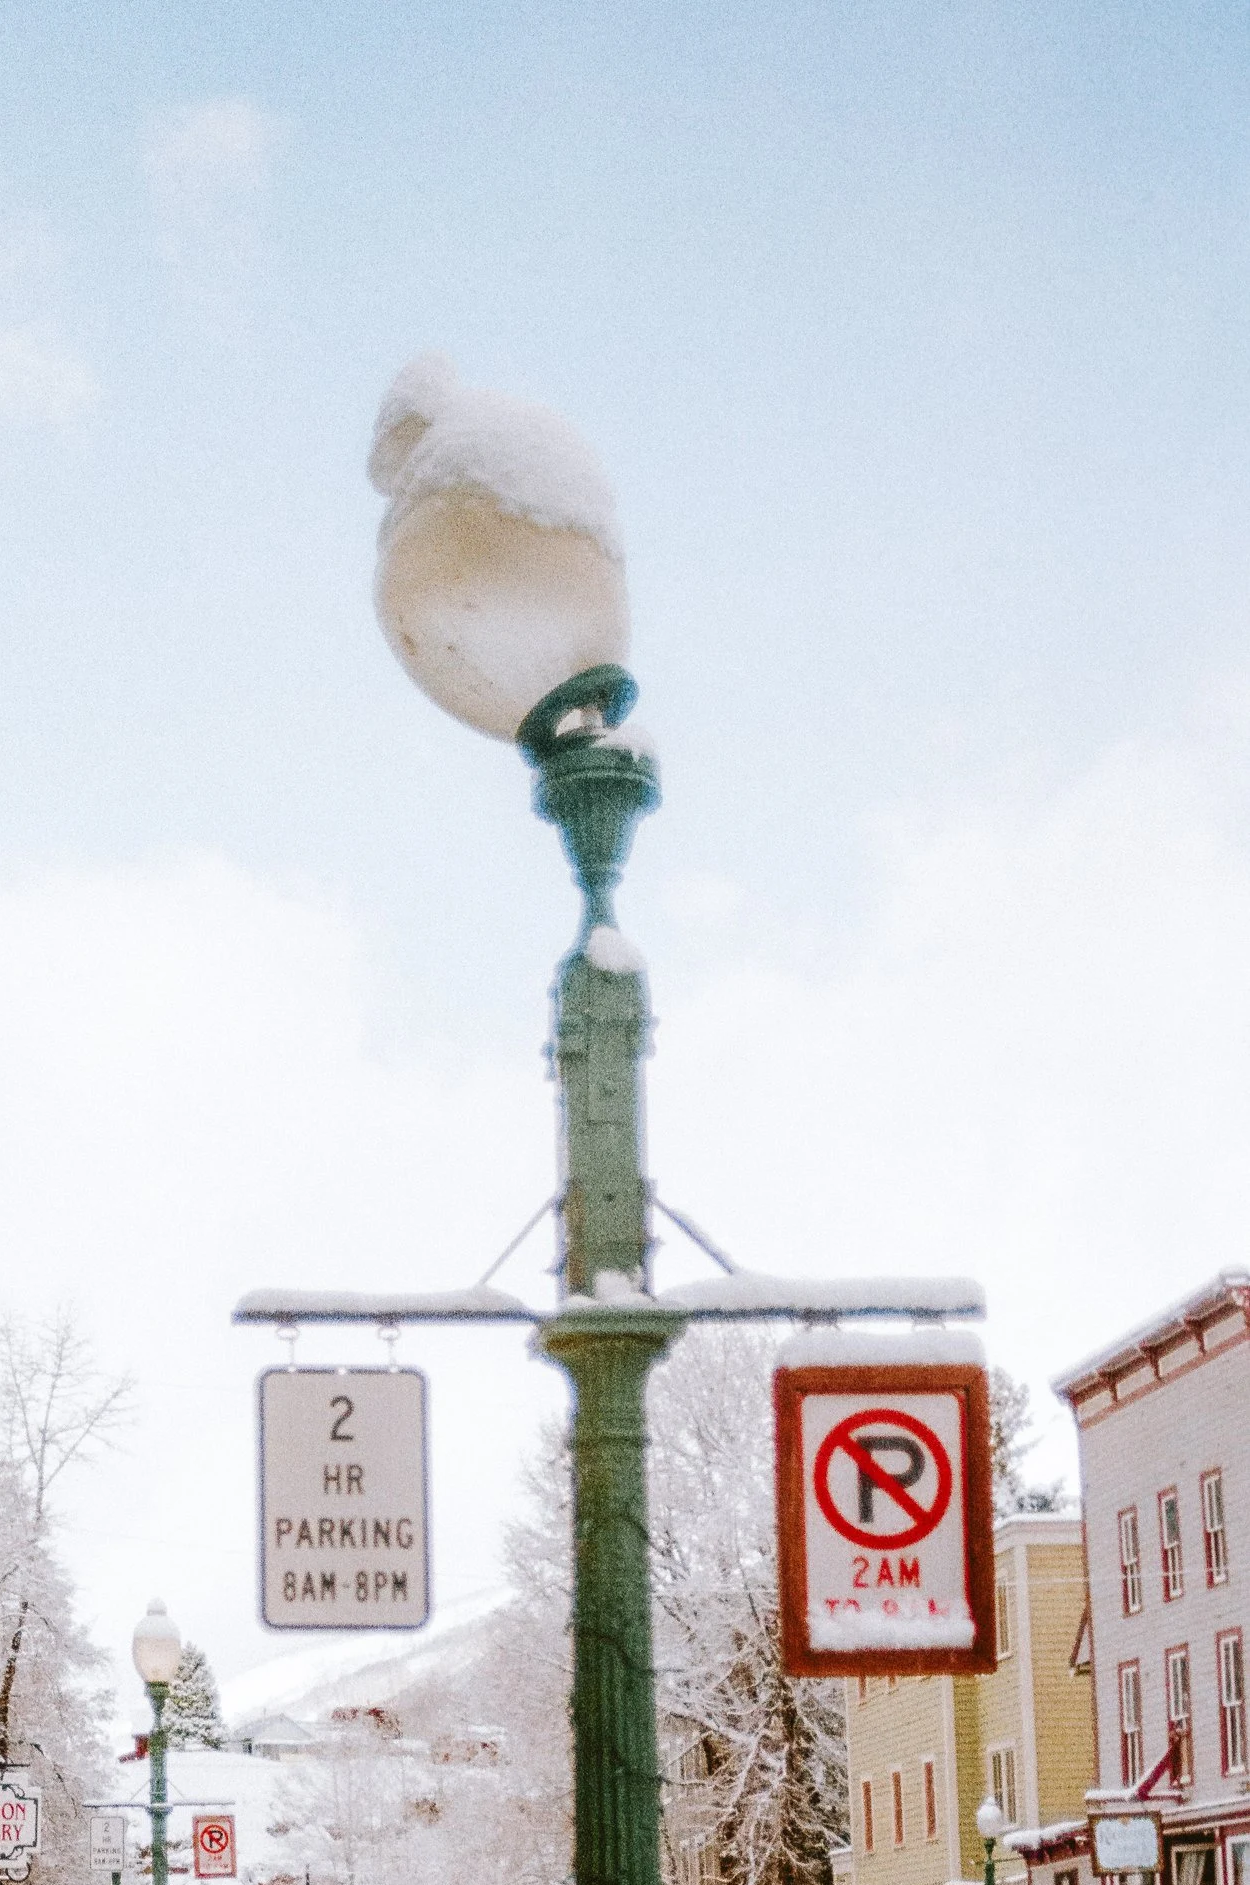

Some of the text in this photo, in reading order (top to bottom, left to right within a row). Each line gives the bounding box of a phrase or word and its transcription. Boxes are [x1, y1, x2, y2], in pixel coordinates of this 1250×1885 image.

[330, 1394, 354, 1441] 2
[322, 1464, 364, 1495] HR
[275, 1517, 414, 1549] PARKING
[852, 1554, 922, 1590] 2AM
